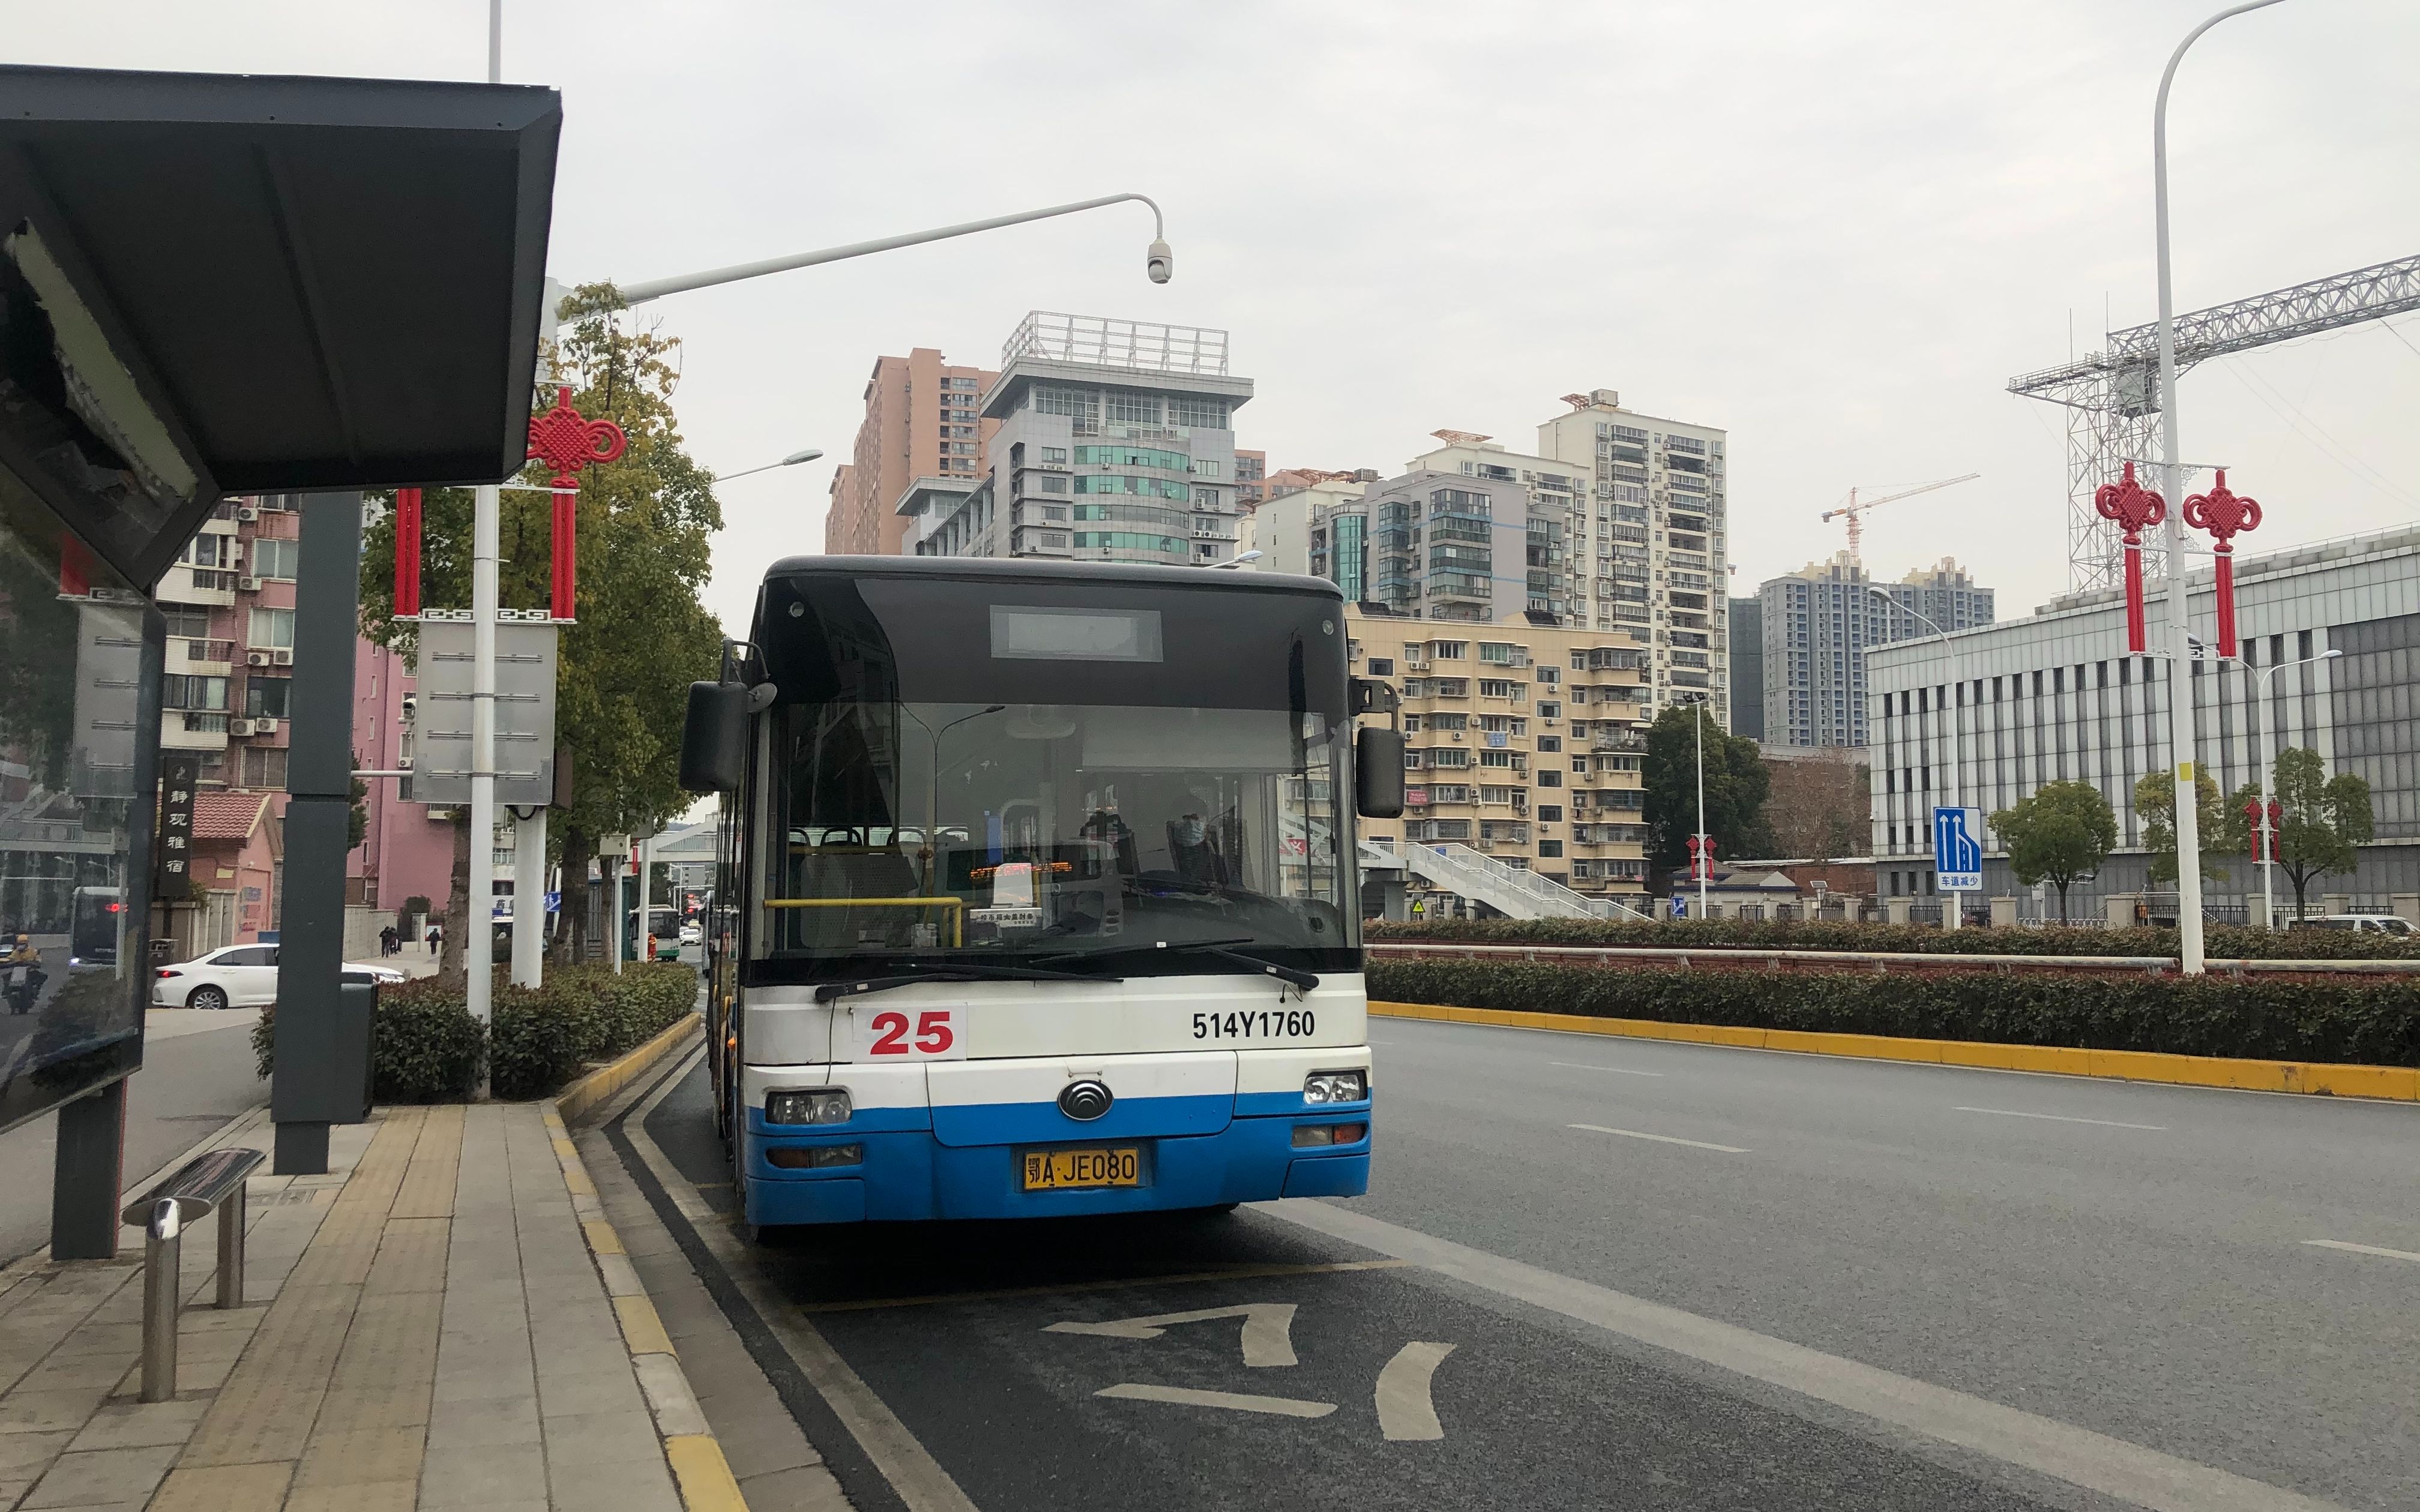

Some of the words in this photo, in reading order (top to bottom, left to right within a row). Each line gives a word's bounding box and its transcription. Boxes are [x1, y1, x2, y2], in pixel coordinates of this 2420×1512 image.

[167, 790, 188, 873] 静观雅宿
[1941, 876, 1978, 886] 车道减少
[870, 1011, 953, 1055] 25
[1193, 1011, 1314, 1039] 514Y1760
